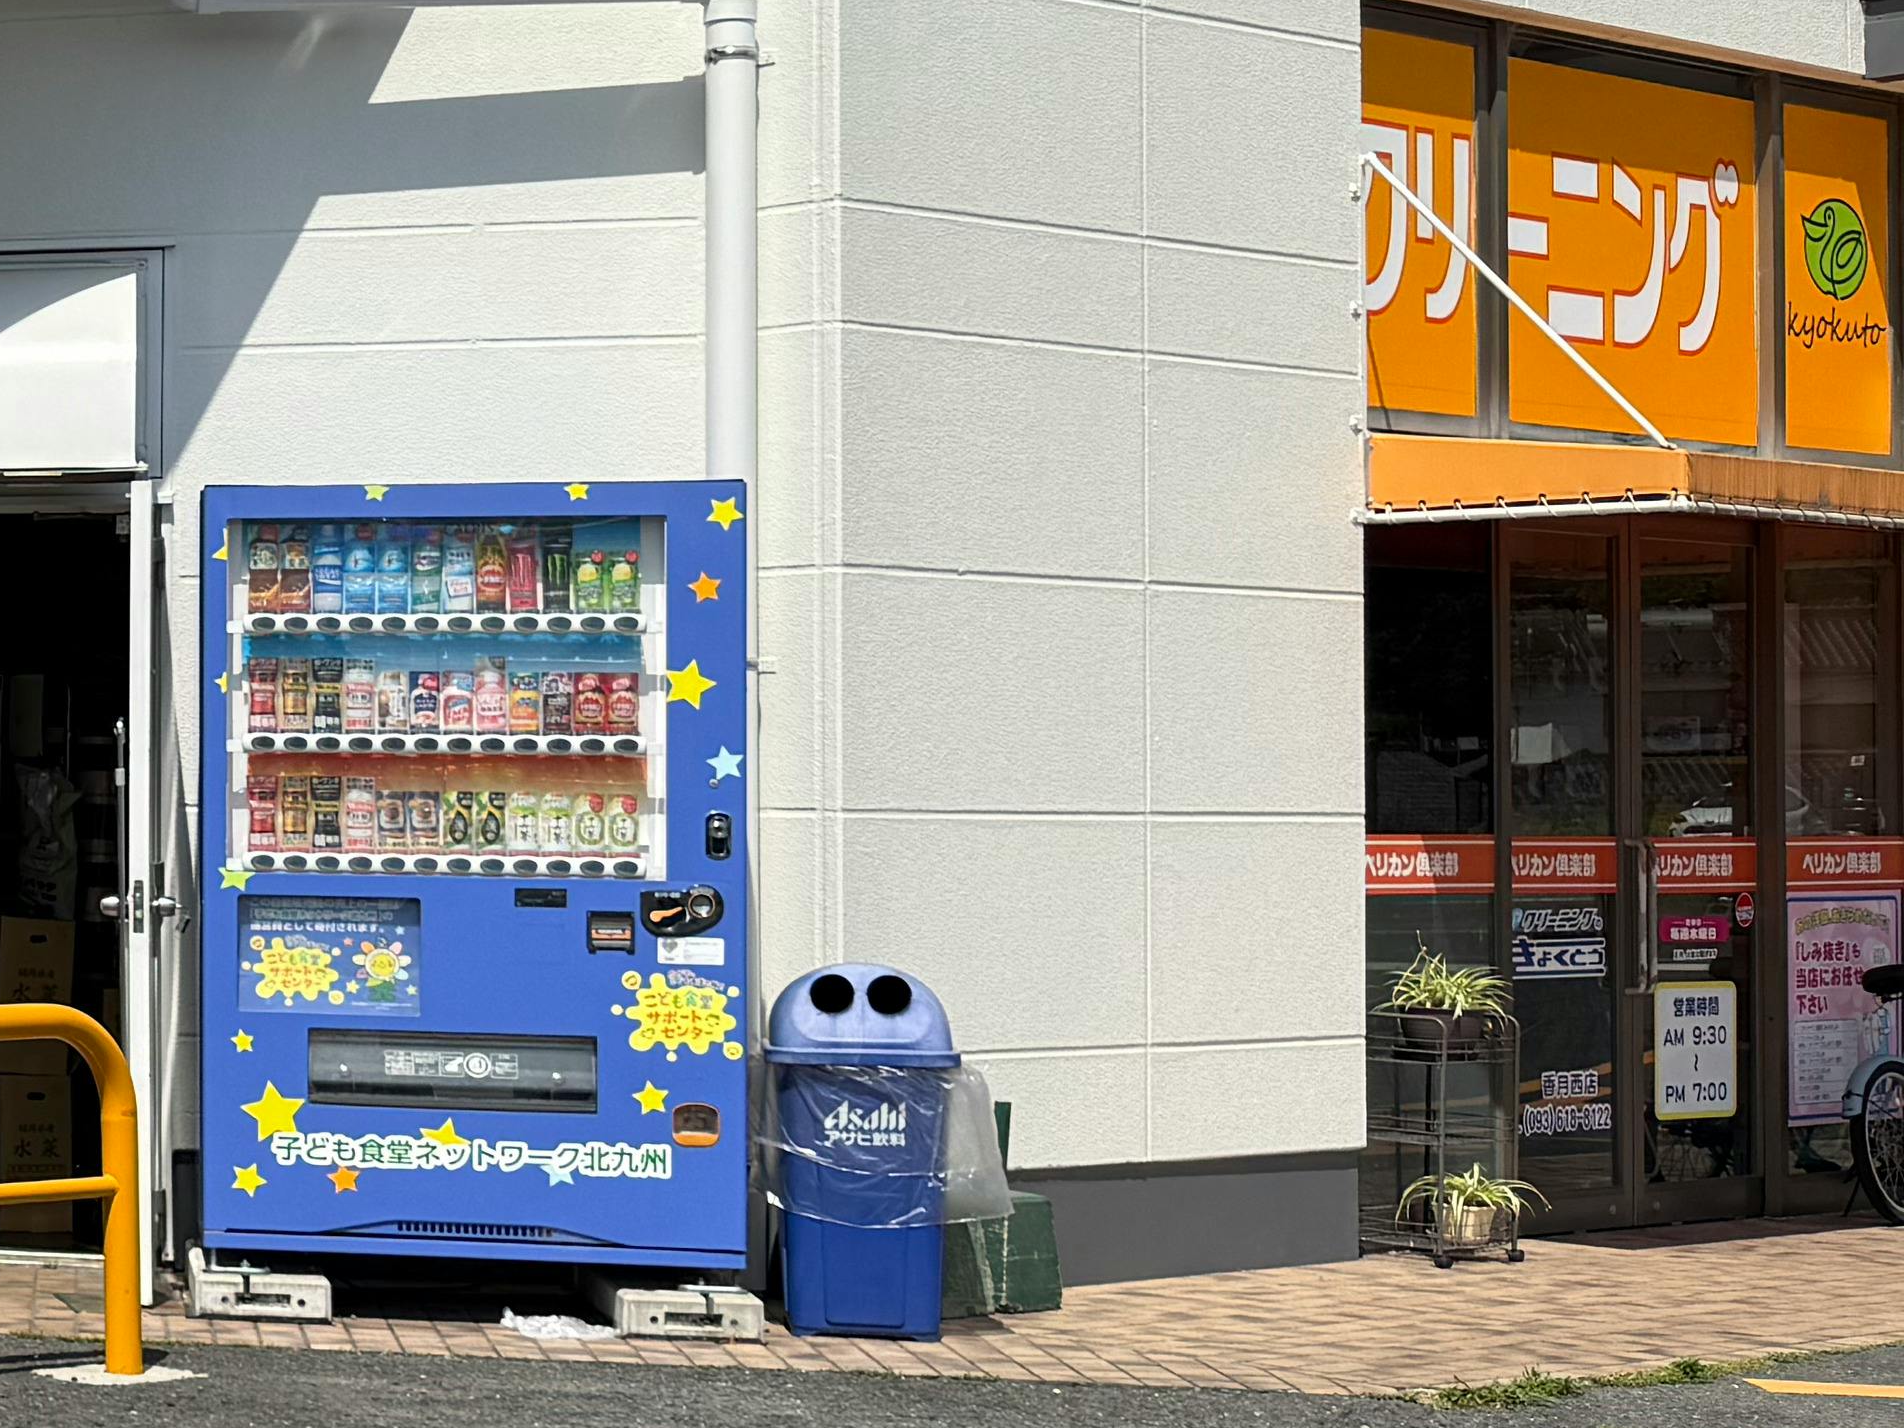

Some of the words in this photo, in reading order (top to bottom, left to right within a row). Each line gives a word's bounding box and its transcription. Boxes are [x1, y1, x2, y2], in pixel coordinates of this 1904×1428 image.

[1788, 302, 1886, 348] kyokuto
[644, 991, 713, 1010] こども食堂
[1673, 996, 1719, 1017] 営業時間
[1796, 994, 1828, 1015] 下さい
[646, 1010, 703, 1024] サポート
[661, 1025, 714, 1039] センター
[1664, 1028, 1685, 1046] AM
[1692, 1025, 1727, 1045] 9:30
[1541, 1071, 1599, 1099] 香月西店
[1665, 1085, 1685, 1103] PM
[1692, 1082, 1727, 1102] 7:00
[824, 1100, 907, 1131] Asahi
[824, 1131, 906, 1147] アサヒ飲料
[275, 1136, 667, 1174] 子ども食堂ネットワーク北九州
